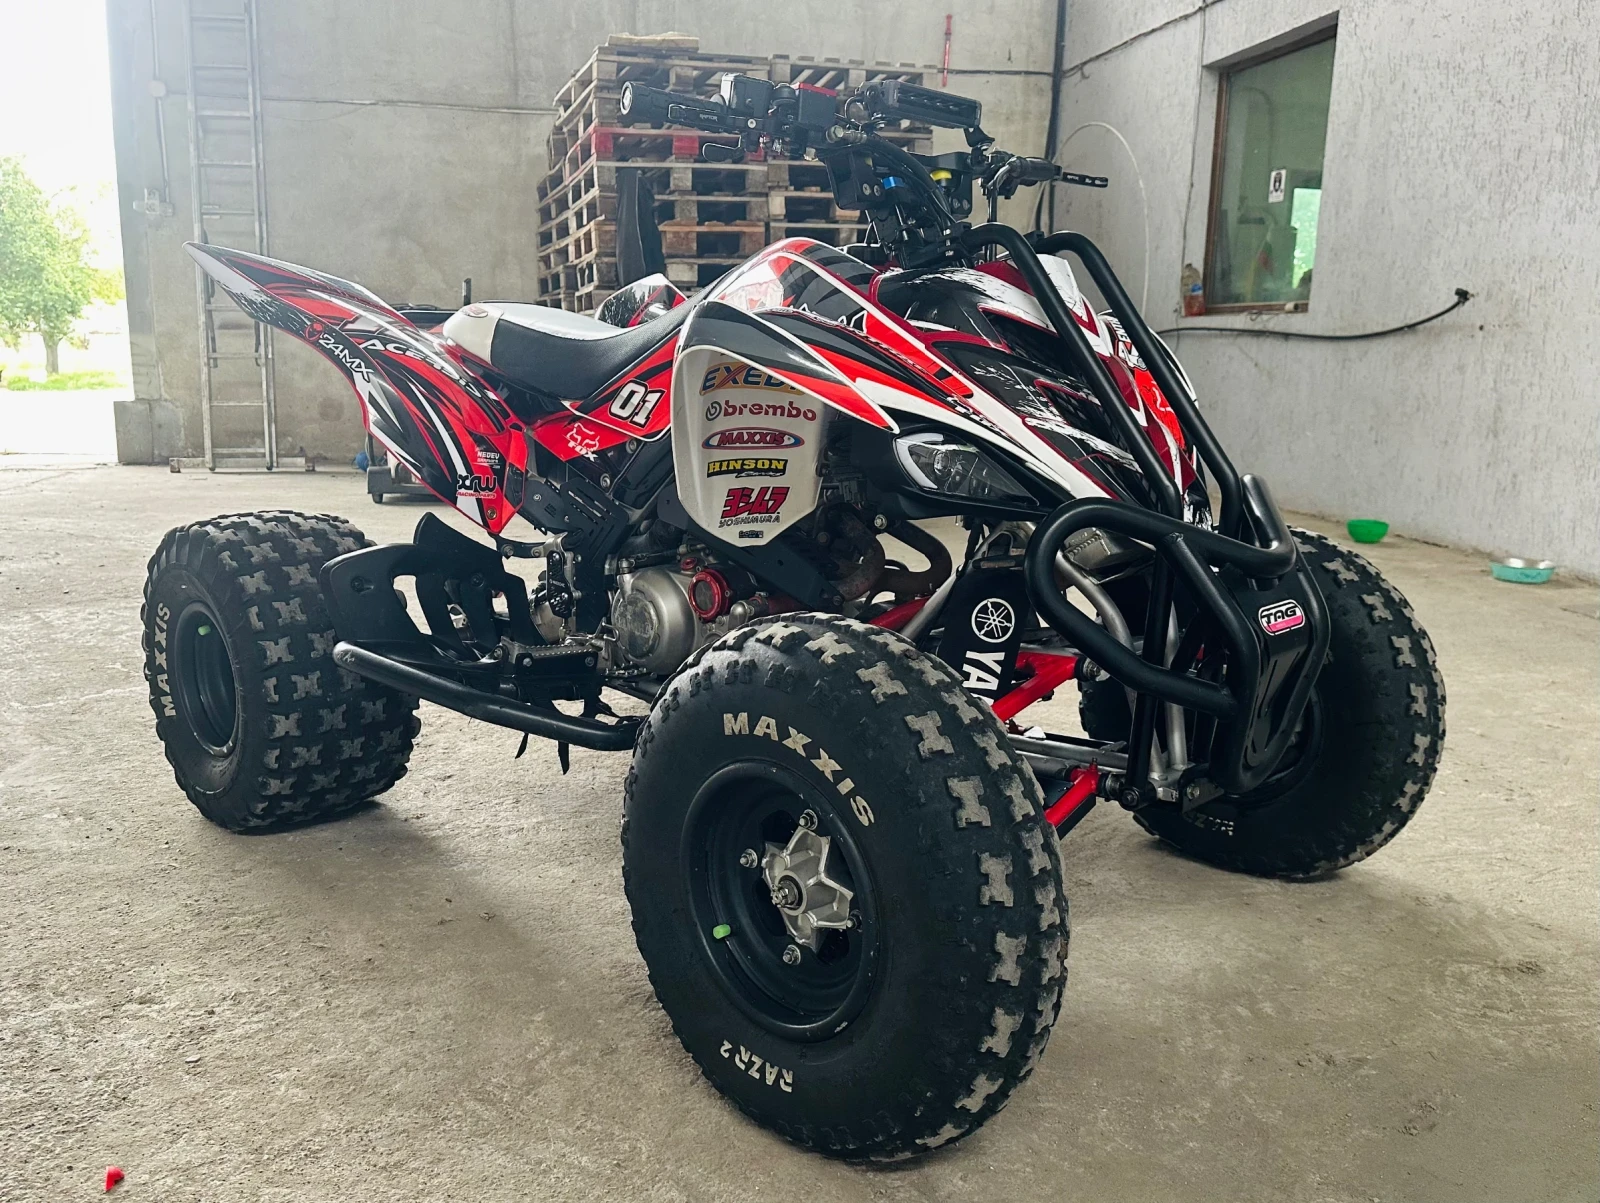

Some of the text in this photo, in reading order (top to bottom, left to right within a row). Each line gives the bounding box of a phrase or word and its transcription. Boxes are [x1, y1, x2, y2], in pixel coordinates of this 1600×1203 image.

[317, 333, 375, 382] 24MX
[702, 365, 797, 391] EXED
[608, 379, 667, 430] 01
[723, 400, 817, 421] brembo
[716, 431, 786, 447] MAXXIS
[567, 440, 599, 462] FOX
[708, 459, 785, 473] HINSON
[718, 515, 781, 528] YOSHIMURA
[1260, 604, 1299, 626] TAG
[154, 602, 177, 717] MAXXIS
[723, 712, 875, 827] MAXXIS
